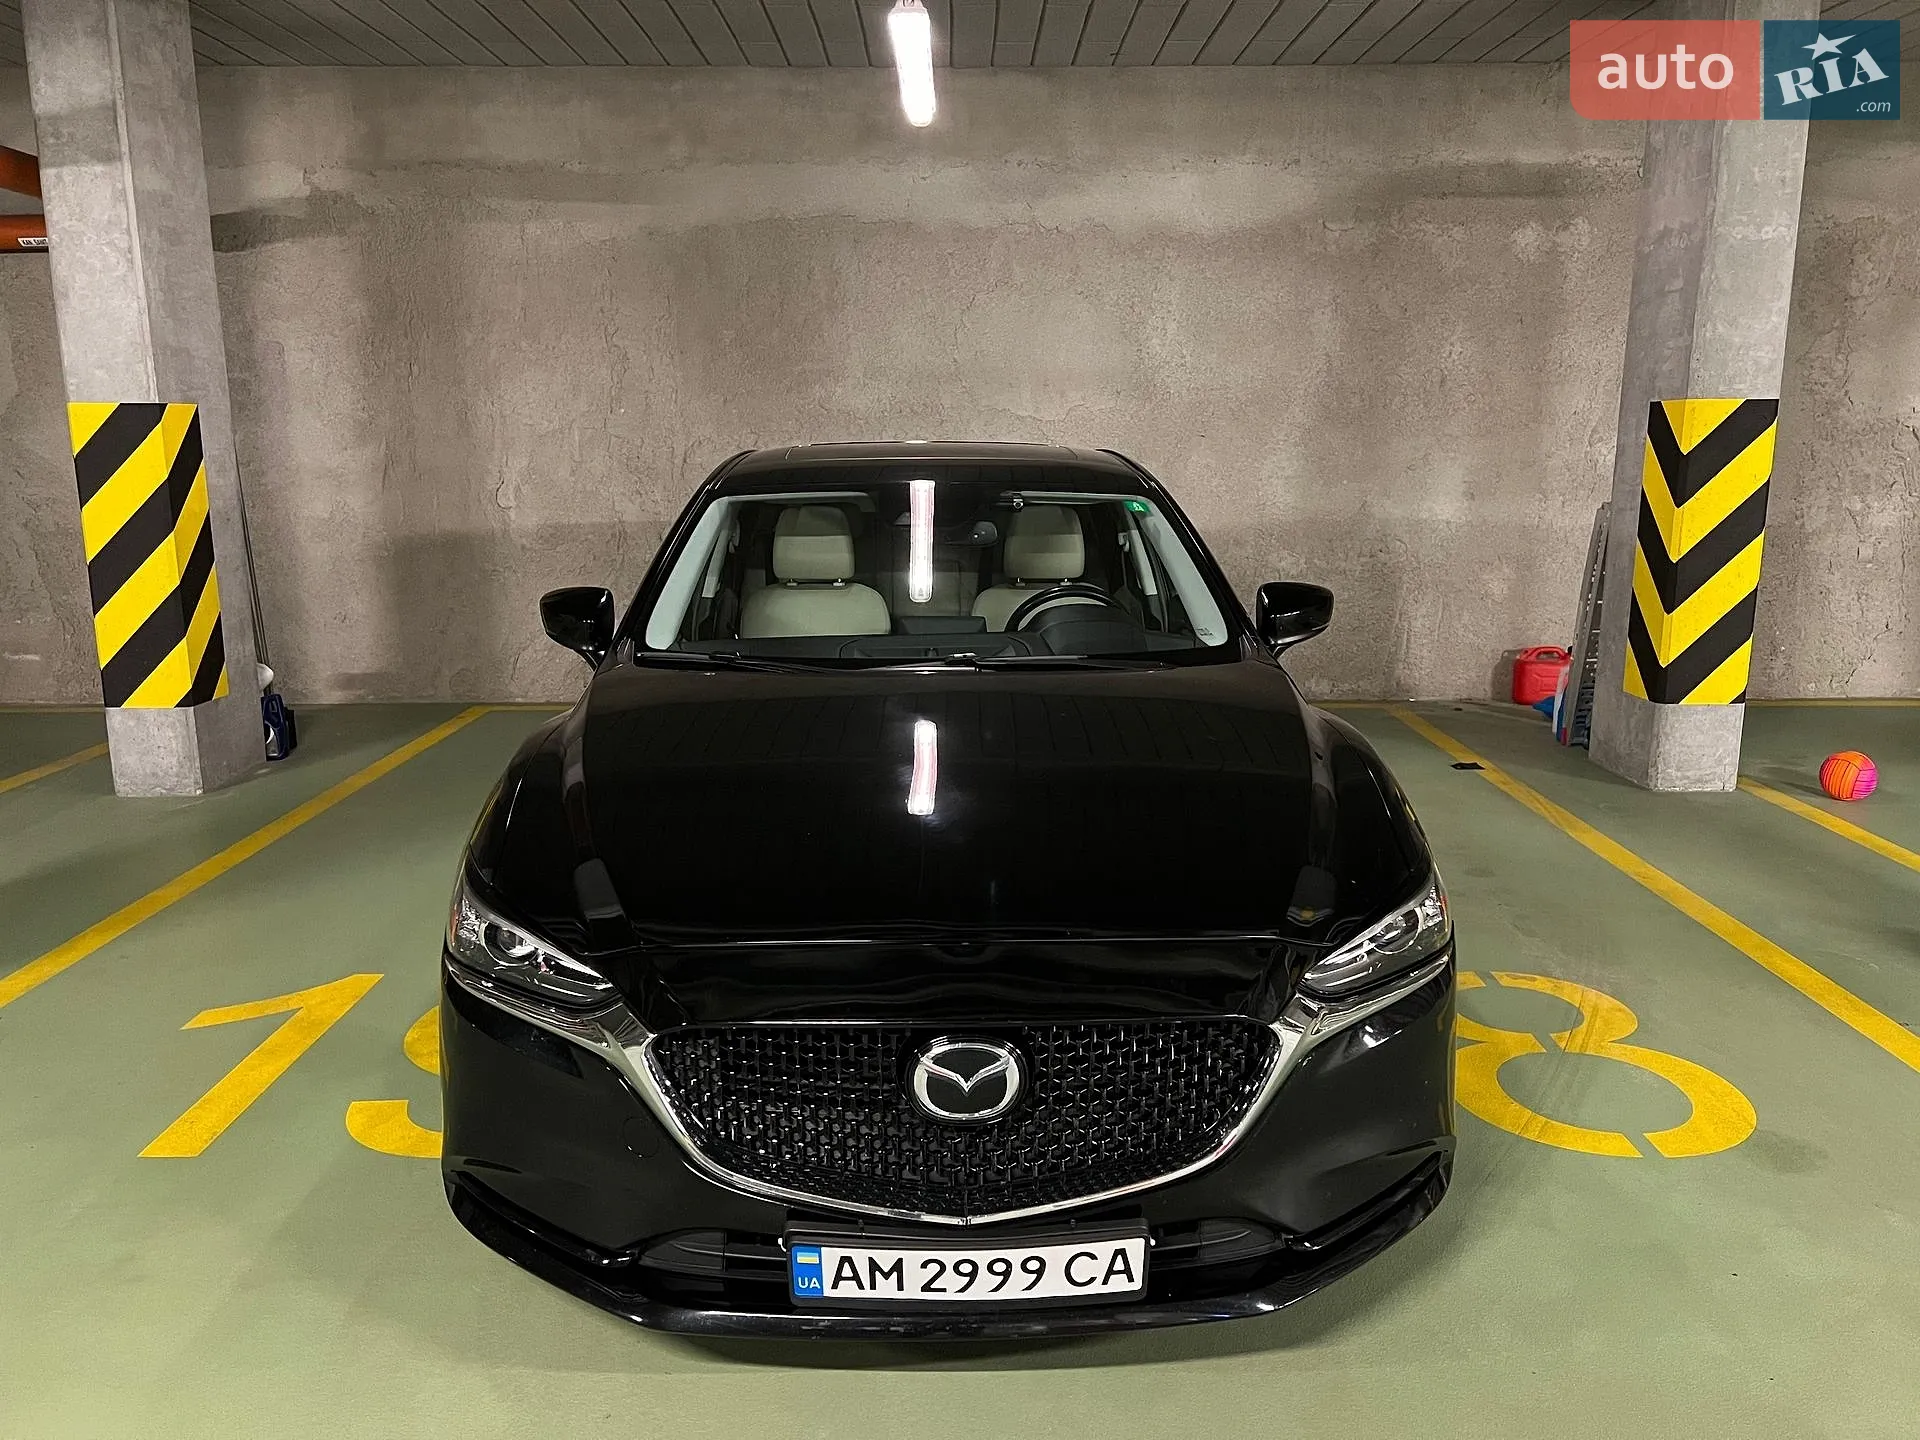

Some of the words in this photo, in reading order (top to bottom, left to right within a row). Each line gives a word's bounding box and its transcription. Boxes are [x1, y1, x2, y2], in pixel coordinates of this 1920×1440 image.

[798, 1276, 821, 1290] UA
[830, 1255, 905, 1292] AM
[919, 1254, 1047, 1294] 2999
[1063, 1247, 1136, 1288] CA
